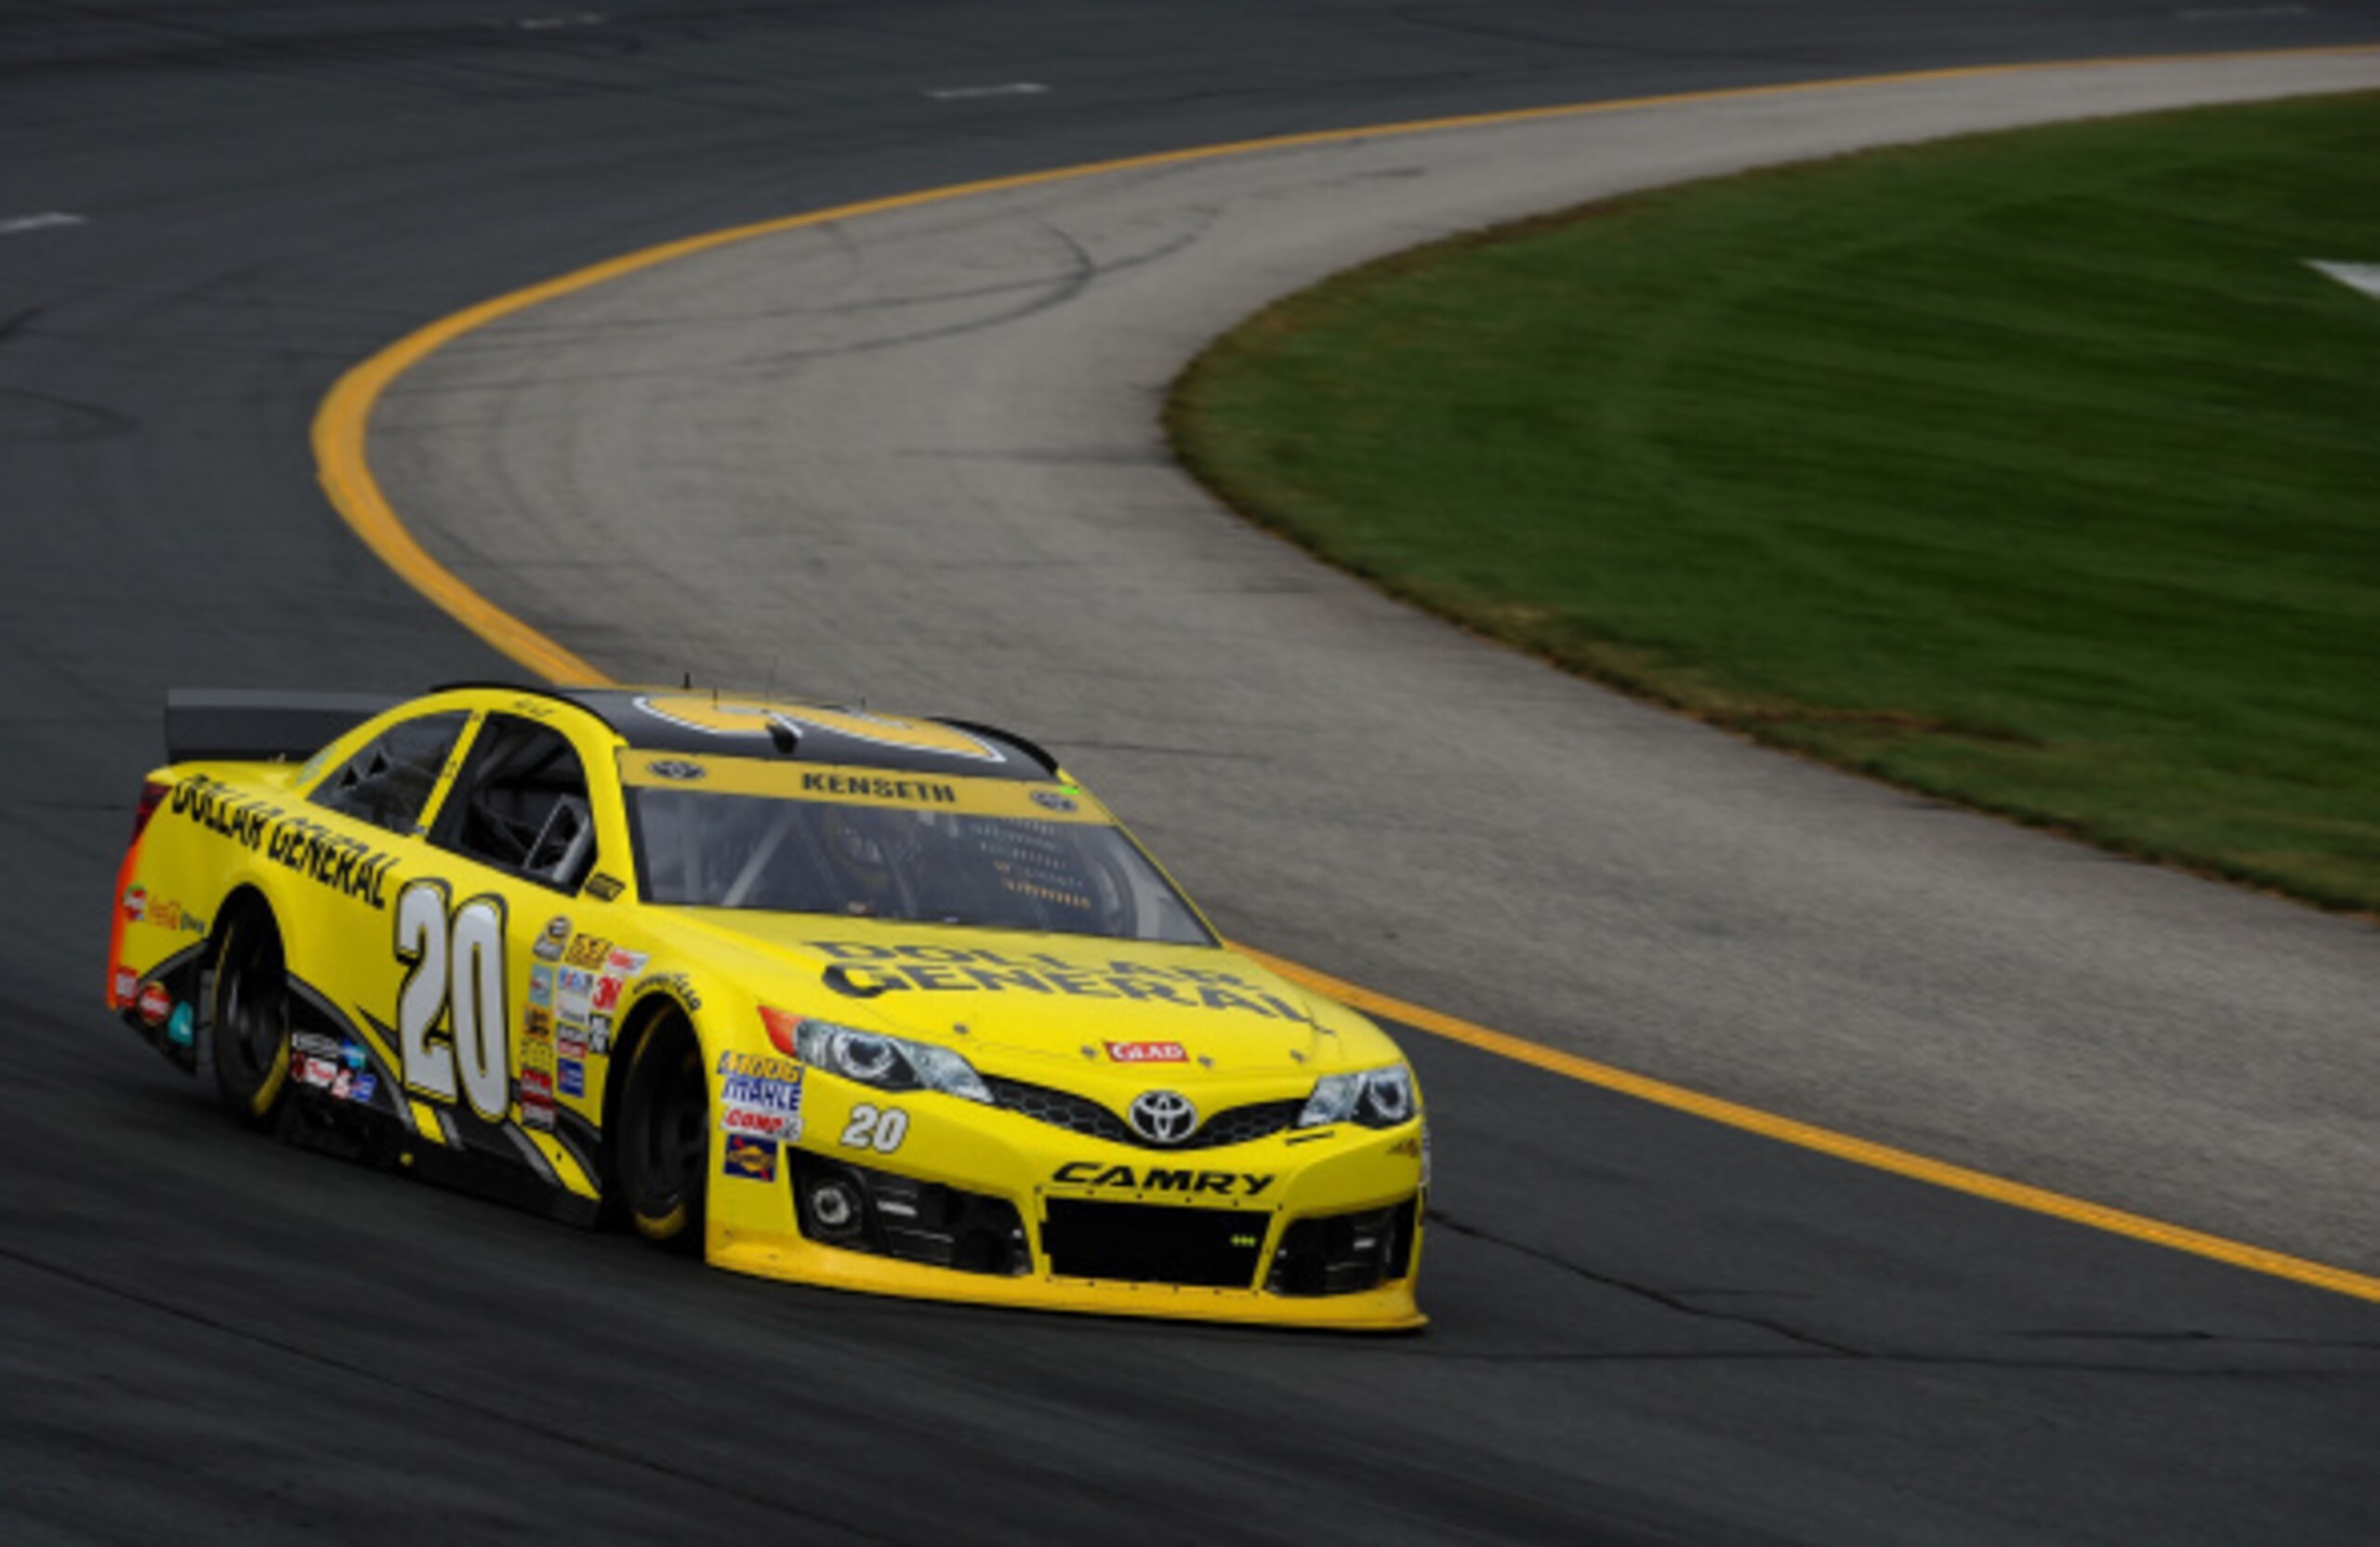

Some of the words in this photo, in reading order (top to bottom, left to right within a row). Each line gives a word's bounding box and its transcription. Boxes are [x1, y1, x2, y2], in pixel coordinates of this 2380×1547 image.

[801, 773, 957, 803] KENSETH
[171, 774, 284, 852] DOLLAR
[267, 816, 402, 911] GENERAL
[801, 940, 1264, 991] DOLLAR
[393, 877, 509, 1122] 20
[822, 964, 1335, 1036] GENERAL
[1111, 1039, 1184, 1061] GLAD
[841, 1104, 909, 1155] 20
[1051, 1161, 1276, 1197] CAMRY
